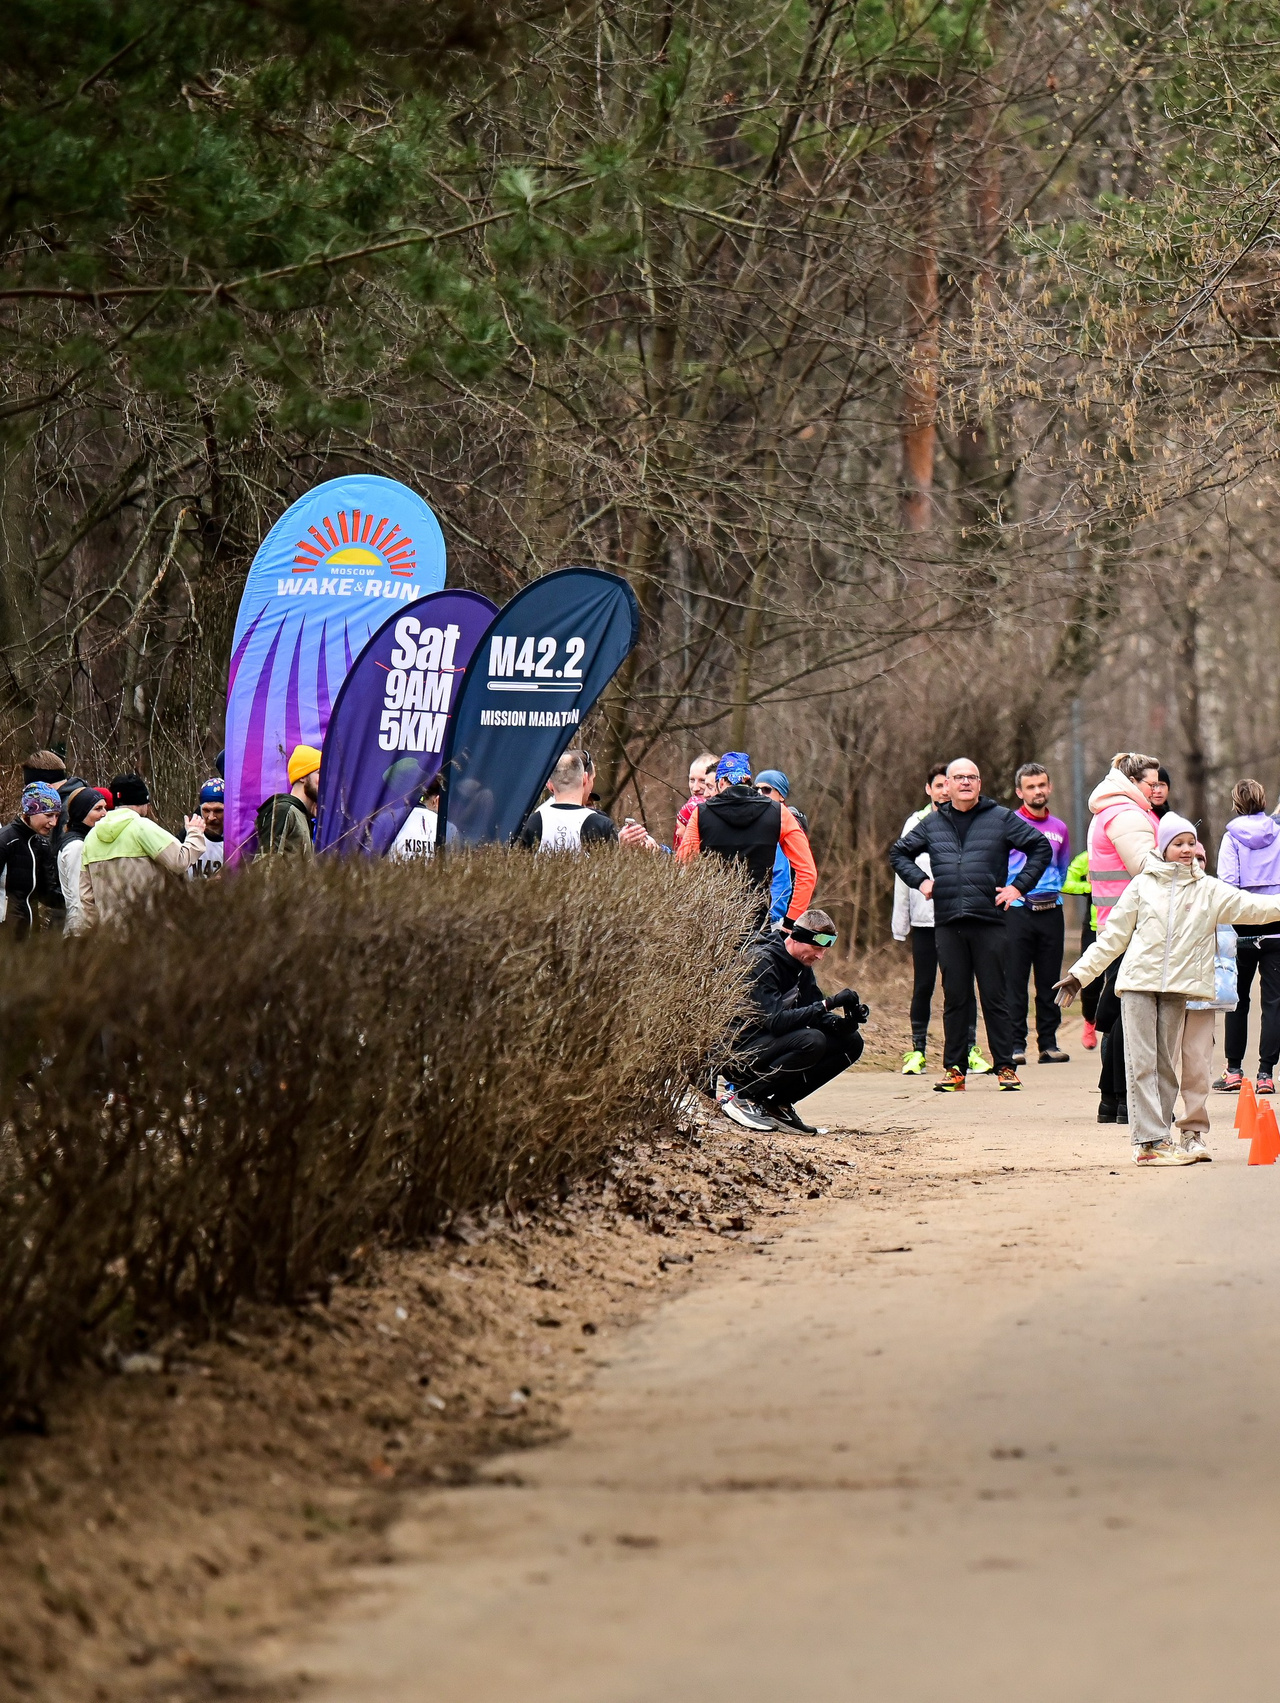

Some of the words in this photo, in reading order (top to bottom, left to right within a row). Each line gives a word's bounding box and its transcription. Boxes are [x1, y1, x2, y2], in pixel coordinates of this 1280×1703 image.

[331, 568, 375, 576] MOSCOW
[391, 616, 461, 673] Sat
[488, 635, 585, 678] M42.2
[384, 669, 454, 713] 9AM
[378, 709, 448, 753] 5KM
[480, 709, 527, 727] MISSION
